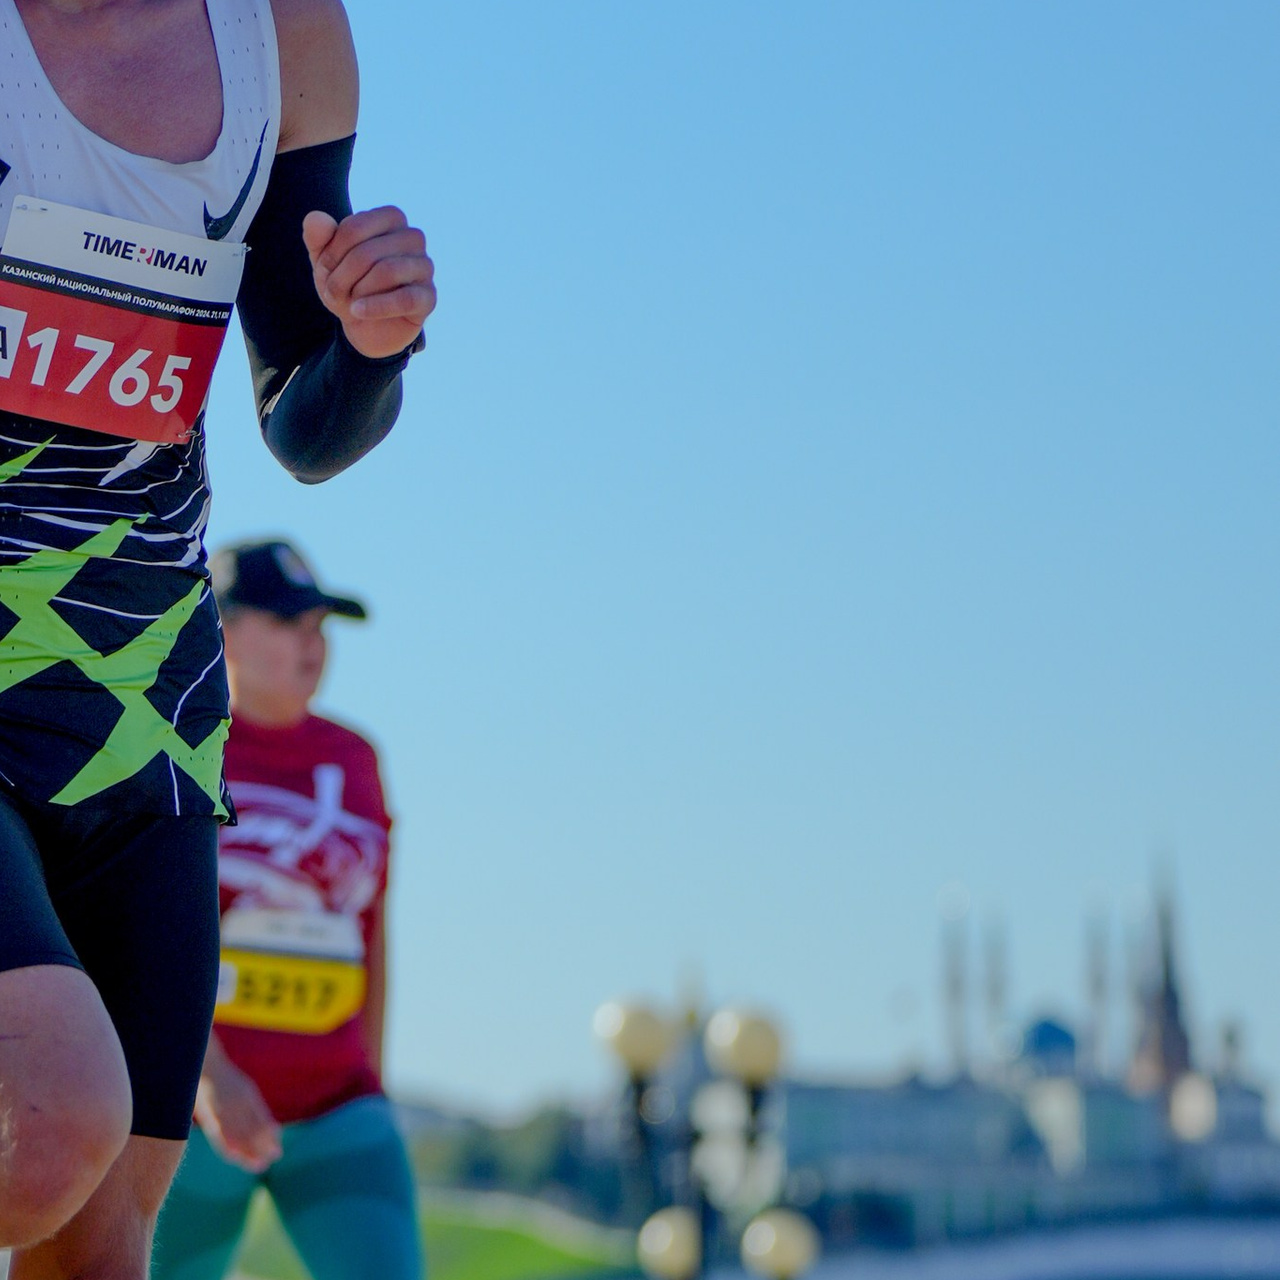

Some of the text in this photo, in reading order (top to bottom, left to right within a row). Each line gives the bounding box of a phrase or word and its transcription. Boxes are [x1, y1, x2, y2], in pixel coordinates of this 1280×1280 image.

[2, 264, 56, 284] КАЗАНСКИЙ
[56, 278, 132, 301] НАЦИОНАЛЬНЫЙ
[132, 296, 196, 317] ПОЛУМАРАФОН
[27, 327, 192, 414] 1765
